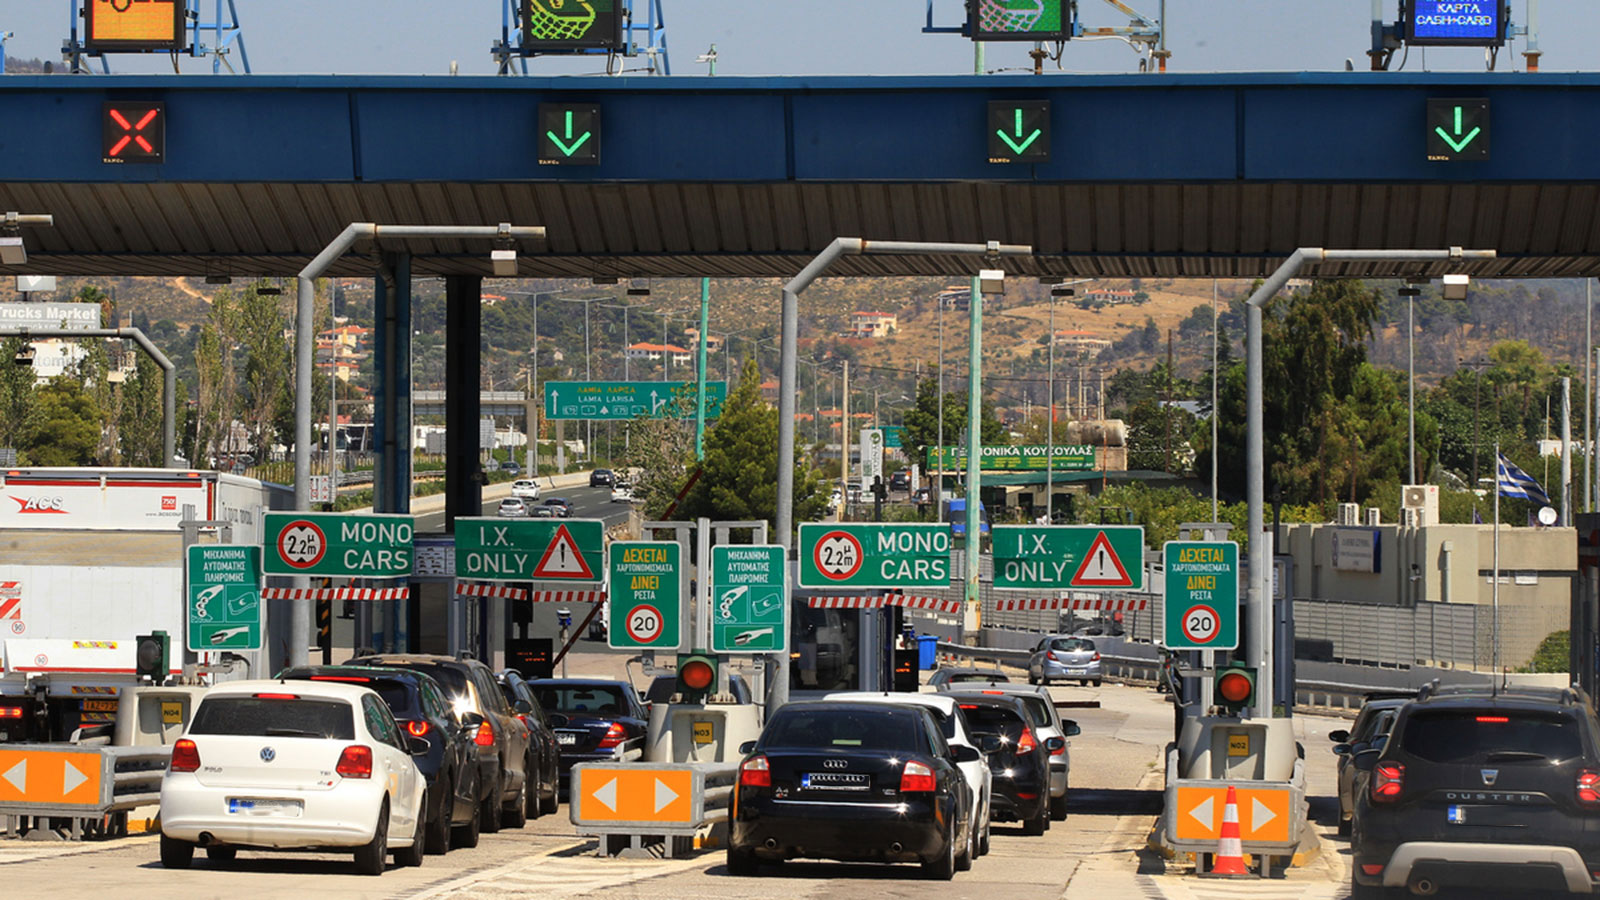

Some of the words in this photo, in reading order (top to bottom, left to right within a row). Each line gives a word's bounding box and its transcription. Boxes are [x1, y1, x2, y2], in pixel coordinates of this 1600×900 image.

[0, 306, 41, 319] rucks
[46, 307, 97, 319] Market
[24, 496, 64, 510] ACS
[344, 549, 409, 570] CARS
[466, 552, 528, 573] ONLY
[623, 548, 667, 563] ΔΕΧΕΤΑΙ
[1179, 548, 1224, 563] ΔΕΧΕΤΑΙ
[880, 559, 946, 580] CARS
[1005, 561, 1066, 582] ONLY
[630, 575, 659, 590] ΔΙΝΕΙ
[1186, 575, 1216, 590] ΔΙΝΕΙ
[634, 590, 656, 600] ΡΕΣΤΑ
[1190, 590, 1212, 600] ΡΕΣΤΑ
[634, 616, 655, 631] 20
[1190, 616, 1212, 631] 20
[1446, 792, 1530, 801] DUSTER
